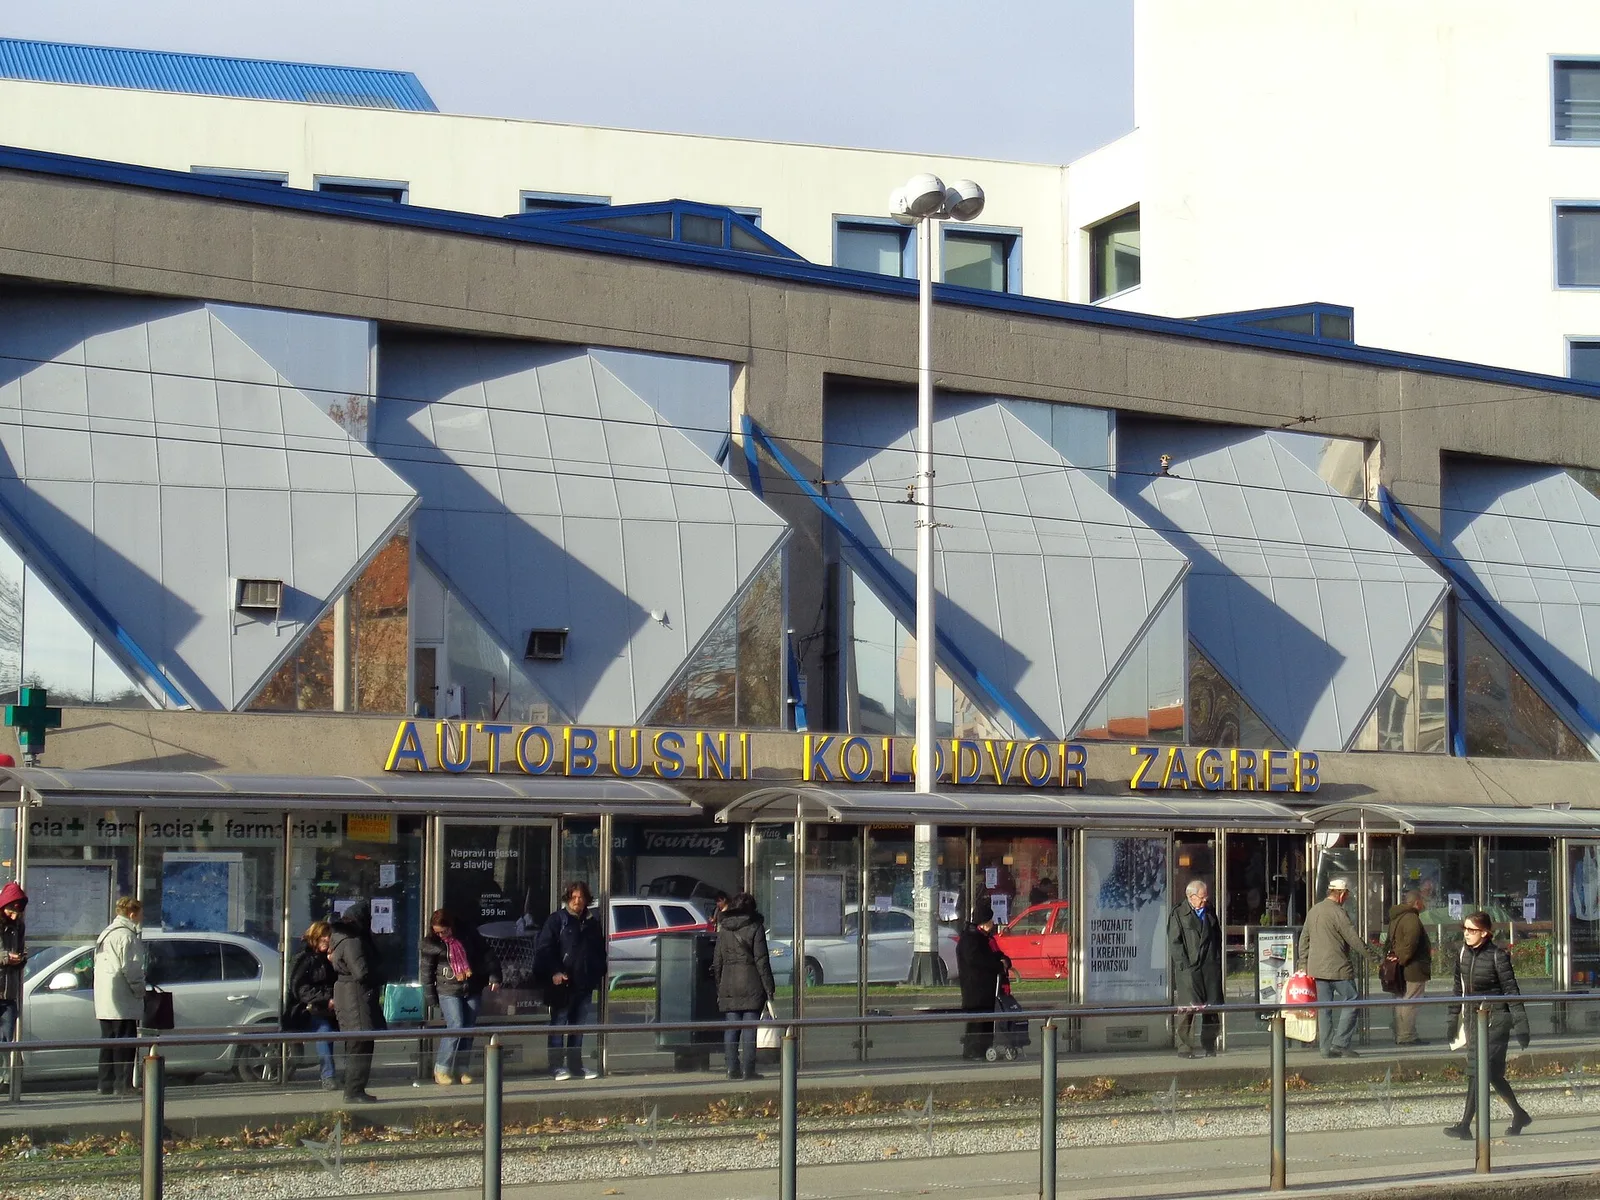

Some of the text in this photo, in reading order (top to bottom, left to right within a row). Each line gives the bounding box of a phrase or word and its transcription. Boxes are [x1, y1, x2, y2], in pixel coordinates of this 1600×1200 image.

[384, 720, 752, 781] AUTOBUSNI
[1130, 746, 1320, 792] ZAGREB
[643, 826, 729, 855] Touring
[450, 849, 519, 860] Napravi mjesta
[463, 860, 493, 871] slavlje
[481, 908, 506, 916] 399 kn
[1090, 919, 1133, 932] UPOZNAJTE
[1090, 933, 1126, 945] PAMETNU
[1096, 946, 1137, 959] KREATIVNU
[1090, 960, 1129, 972] HRVATSKU
